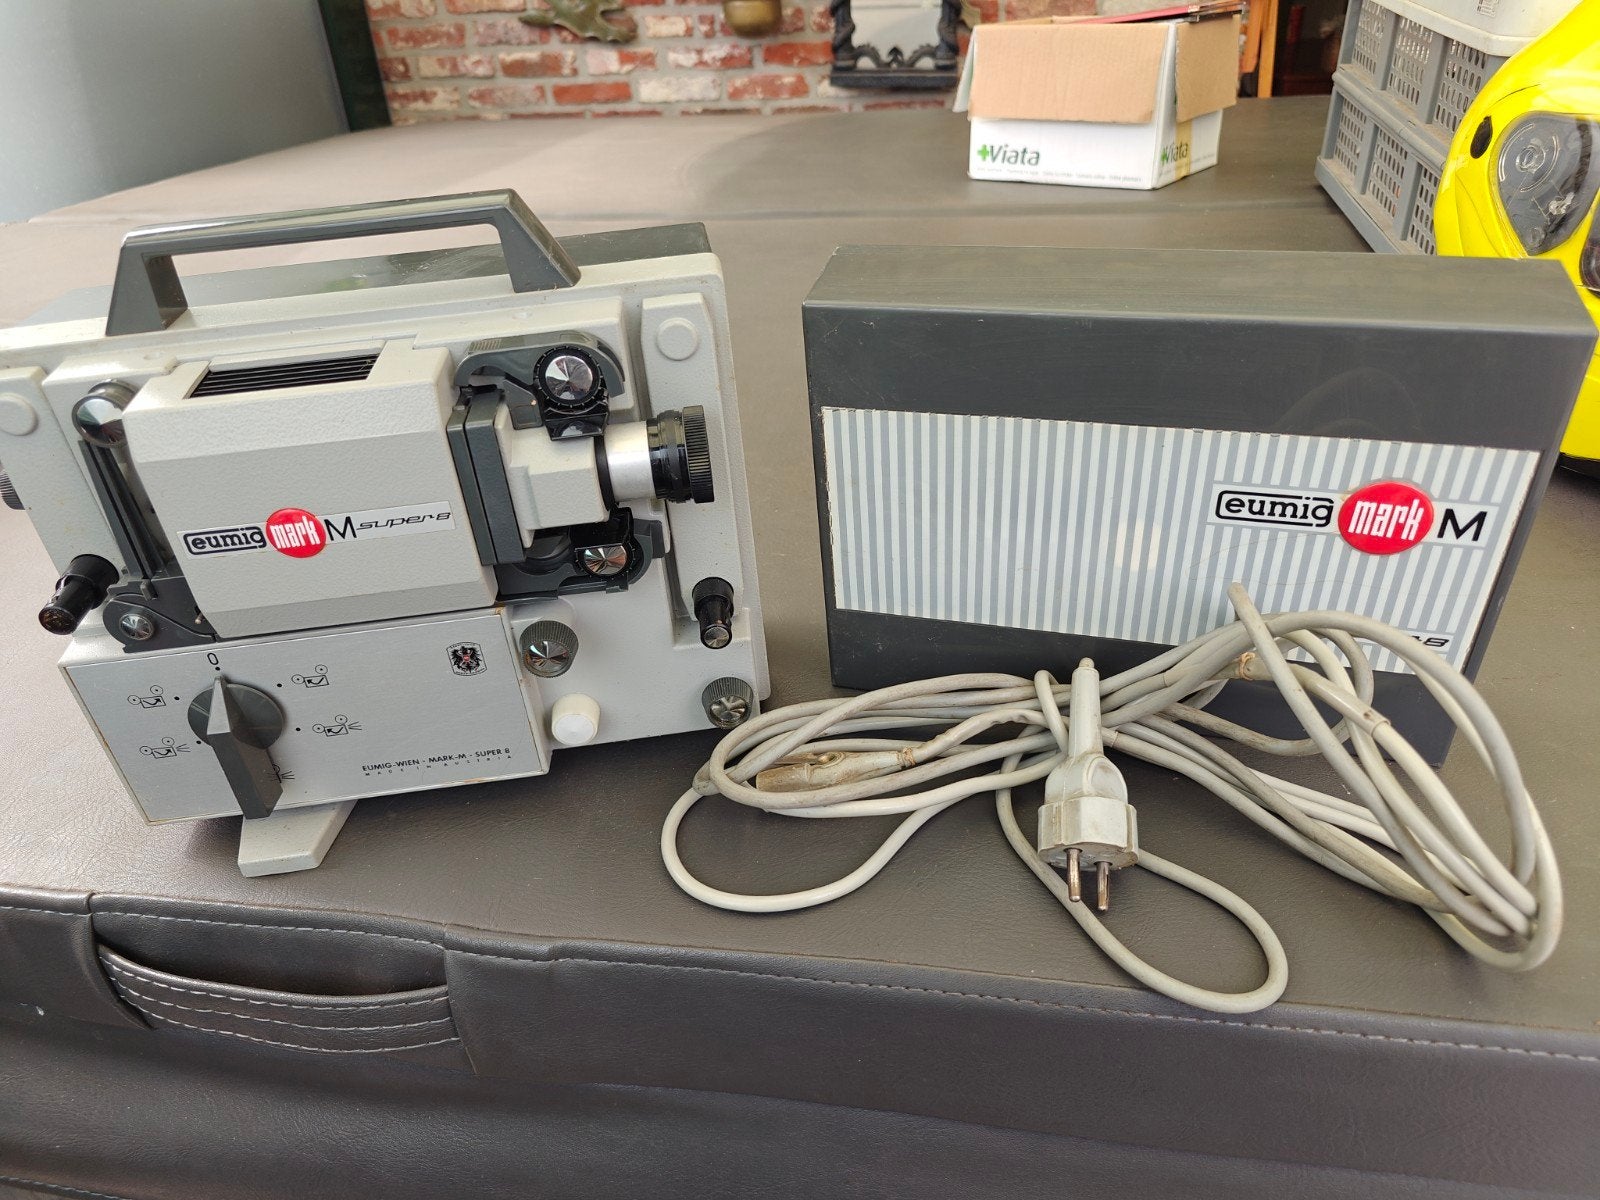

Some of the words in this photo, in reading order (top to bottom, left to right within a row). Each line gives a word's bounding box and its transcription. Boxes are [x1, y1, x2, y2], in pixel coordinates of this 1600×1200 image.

[989, 144, 1041, 167] Viata
[190, 526, 268, 550] eumig
[269, 515, 322, 550] mark
[323, 515, 358, 542] M
[1224, 495, 1335, 528] eumig
[1347, 498, 1425, 542] mark
[1437, 508, 1488, 542] M
[362, 758, 421, 772] EUMIG-WIEN
[428, 753, 467, 764] MARK-M
[475, 748, 503, 758] SUPER
